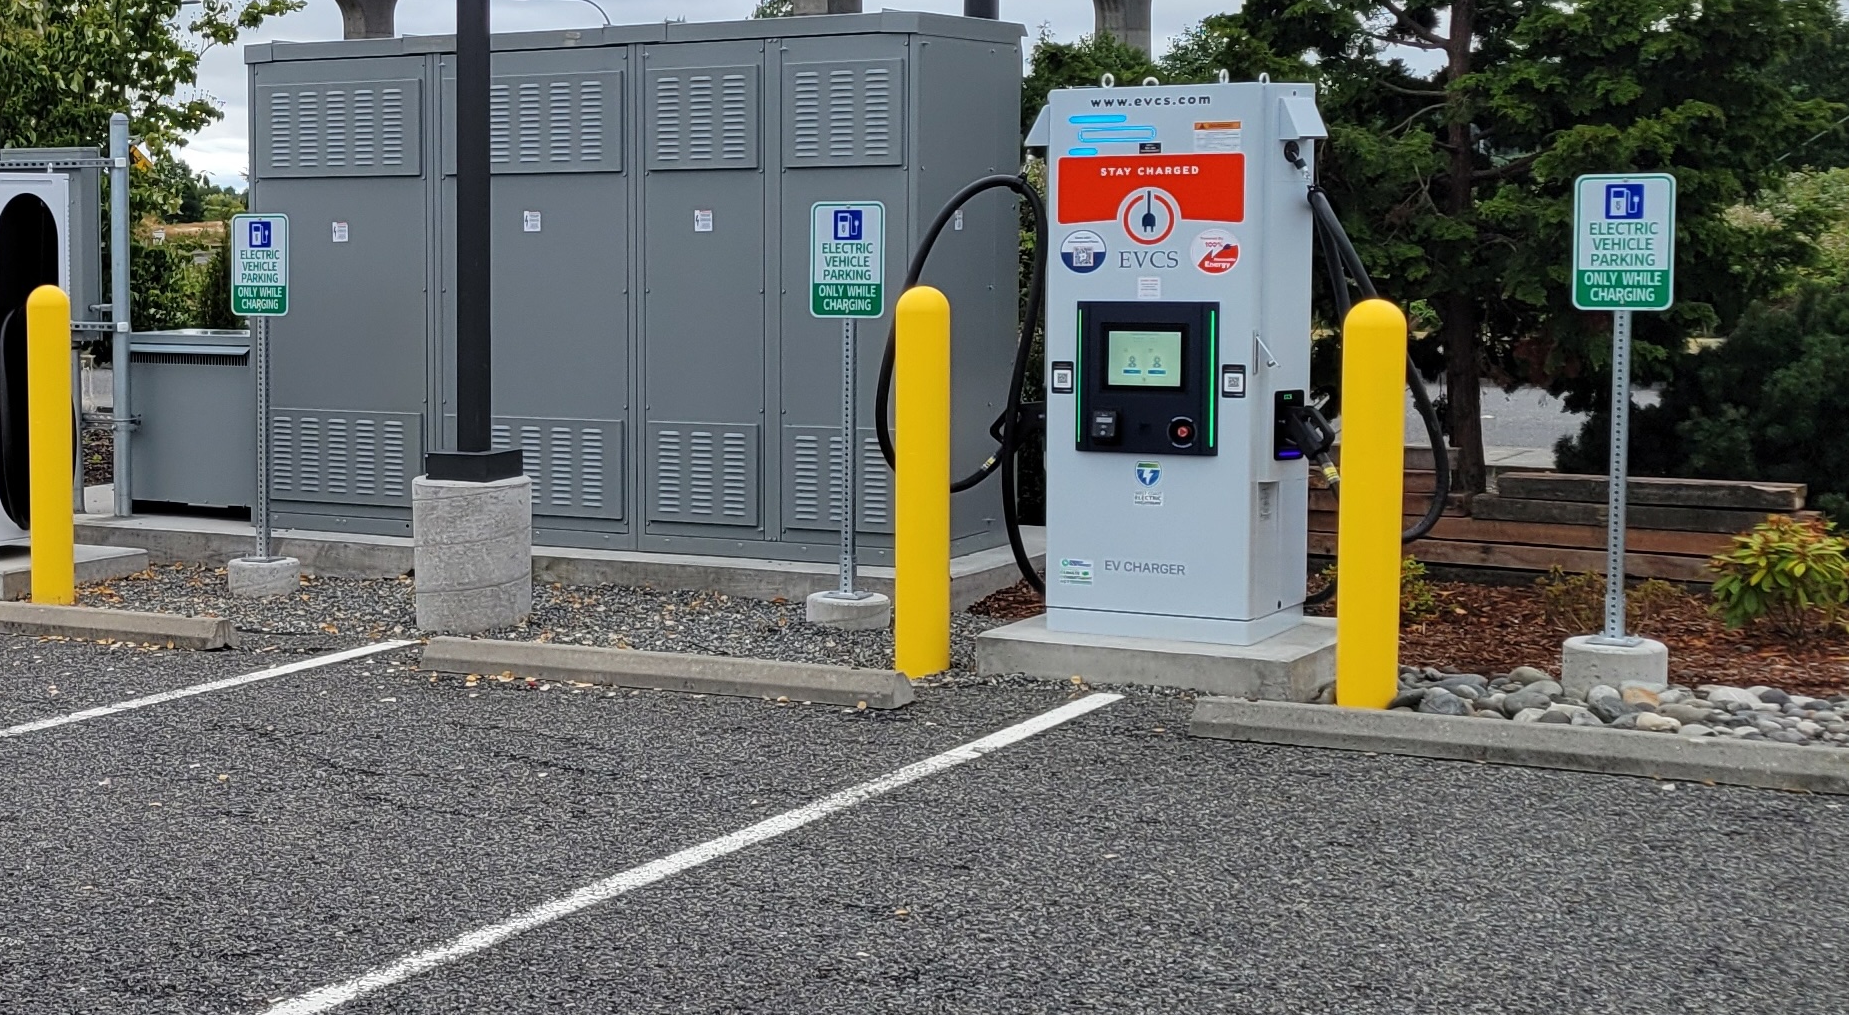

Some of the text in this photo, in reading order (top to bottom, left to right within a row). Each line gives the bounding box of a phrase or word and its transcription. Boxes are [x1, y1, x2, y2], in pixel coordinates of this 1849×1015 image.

[1090, 94, 1212, 108] www.evcs.com
[1100, 165, 1200, 177] STAY CHARGED
[1589, 221, 1659, 236] ELECTRIC
[821, 242, 874, 254] ELECTRIC
[1592, 237, 1654, 251] VEHICLE
[239, 249, 281, 260] ELECTRIC
[1118, 250, 1179, 269] EVCS
[1590, 253, 1656, 267] PARKING
[242, 261, 278, 272] VEHICLE
[824, 255, 871, 268] VEHICLE
[1204, 260, 1231, 269] Energy
[241, 273, 279, 284] PARKING
[822, 269, 872, 281] PARKING
[1583, 271, 1663, 286] ONLY WHILE
[237, 286, 283, 298] ONLY WHILE
[818, 284, 877, 298] ONLY WHILE
[1590, 287, 1655, 302] CHARGING
[241, 299, 279, 310] CHARGING
[823, 298, 872, 311] CHARGING
[1104, 559, 1121, 571] EV
[1123, 561, 1186, 576] CHARGER
